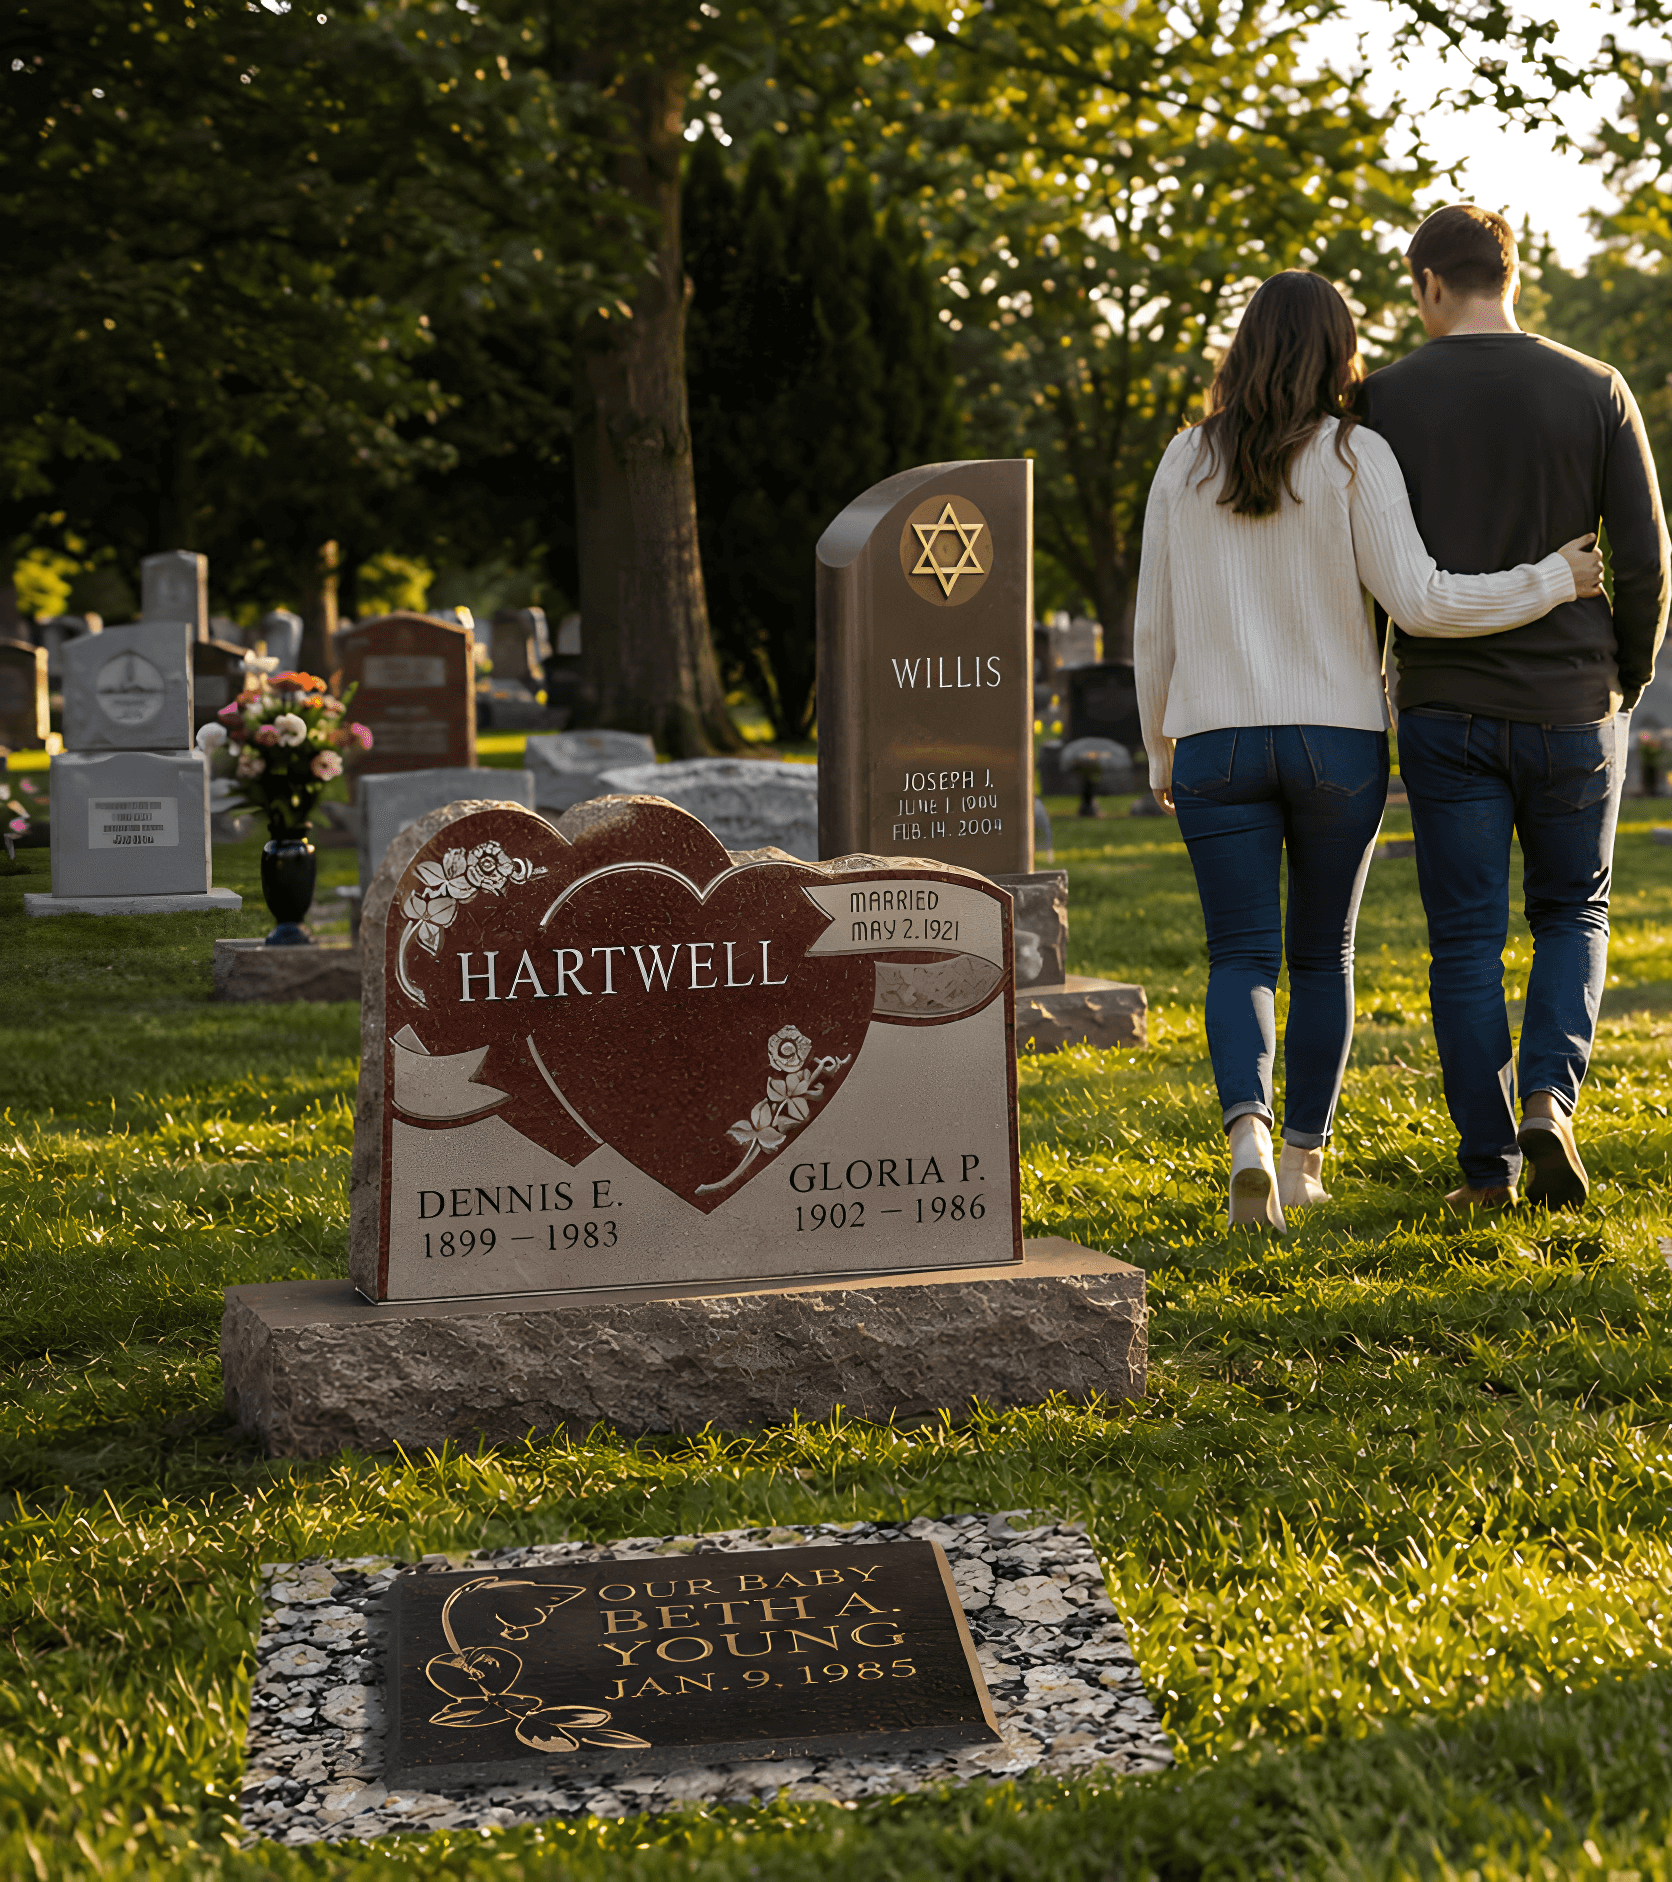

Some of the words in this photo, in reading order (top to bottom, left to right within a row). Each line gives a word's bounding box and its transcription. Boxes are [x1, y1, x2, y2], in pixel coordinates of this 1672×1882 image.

[891, 656, 1001, 689] WILLIS
[902, 770, 974, 792] JOSEPH
[984, 768, 994, 788] J.
[850, 889, 939, 913] MARRIED
[851, 919, 896, 942] MAY
[456, 940, 788, 1001] HARTWELL
[789, 1156, 943, 1193] GLORIA
[960, 1152, 986, 1183] P.
[416, 1183, 577, 1219] DENNIS
[591, 1179, 623, 1208] E.
[796, 1201, 867, 1232] 1902
[914, 1193, 986, 1223] 1986
[422, 1229, 497, 1259] 1899
[546, 1221, 620, 1251] 1983
[598, 1577, 720, 1602] OUR
[738, 1565, 884, 1592] BABY
[603, 1596, 816, 1635] BETH
[835, 1591, 901, 1618] A.
[597, 1620, 905, 1668] YOUNG
[603, 1672, 729, 1701] JAN.
[797, 1658, 918, 1686] 1985
